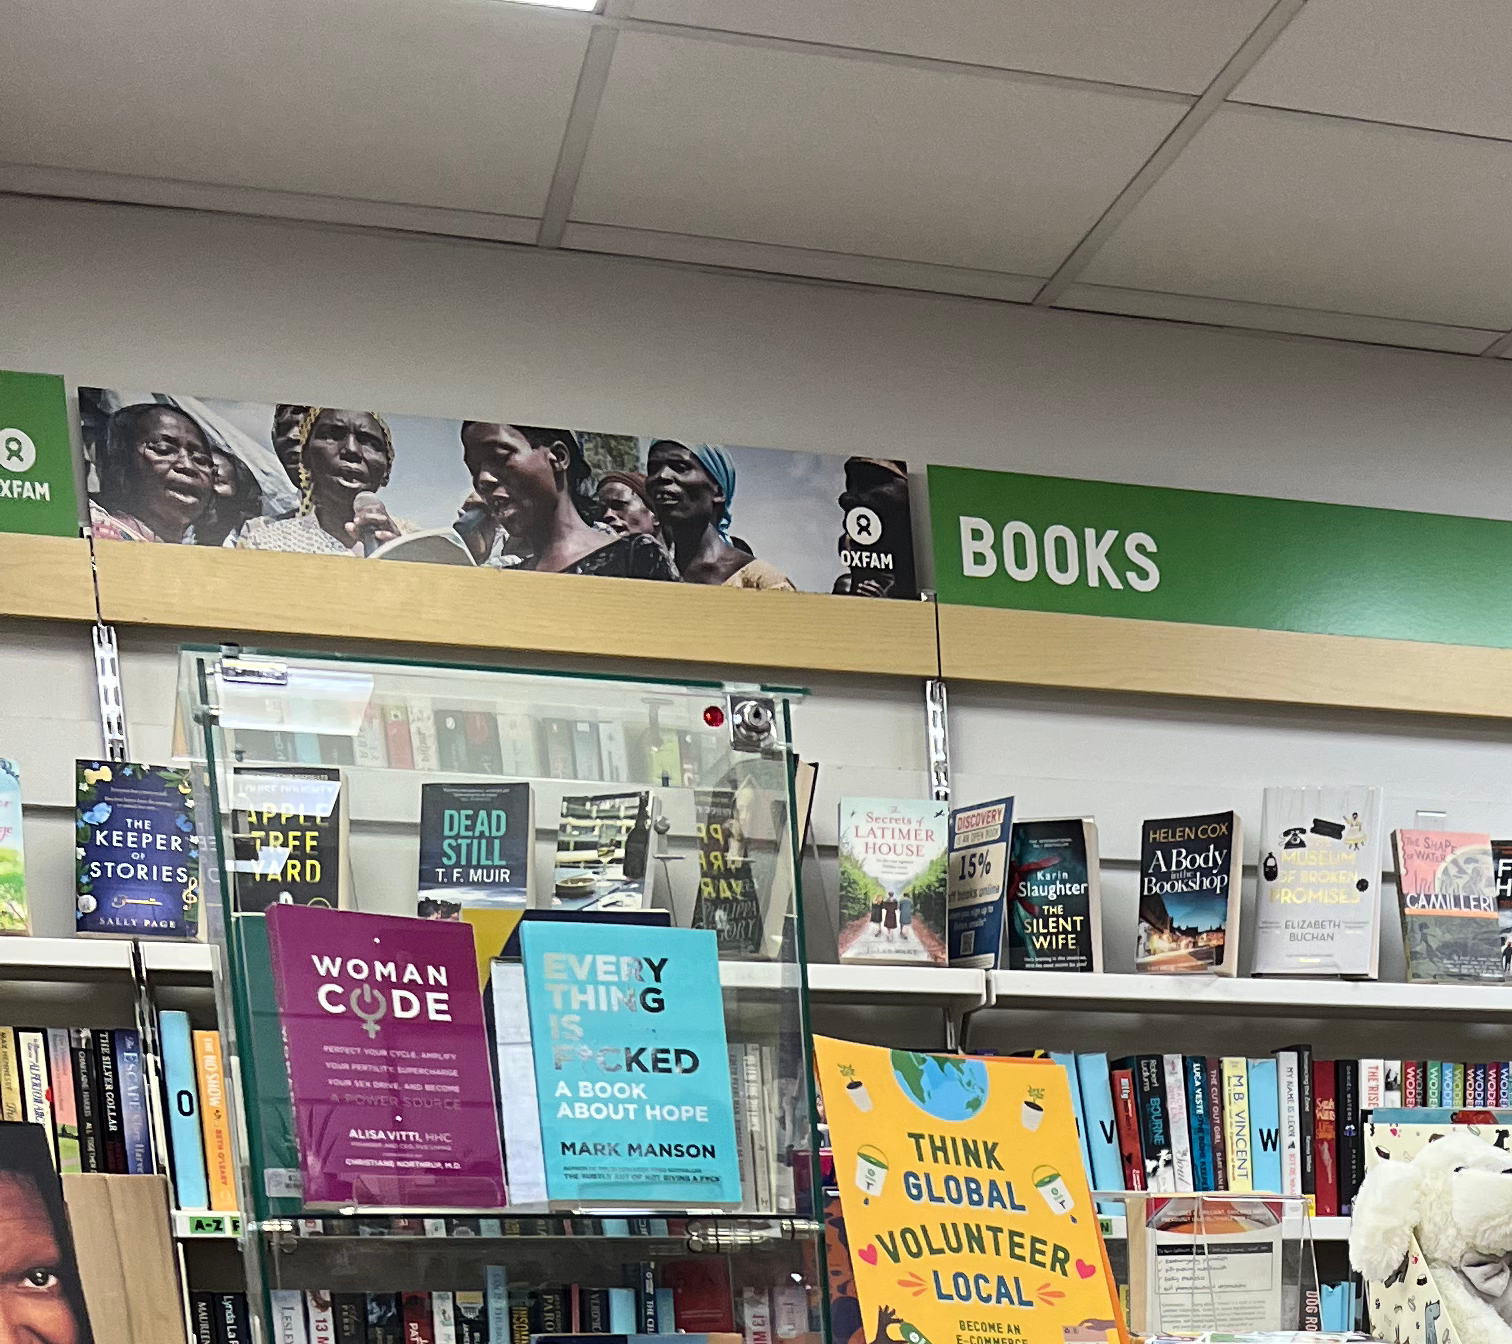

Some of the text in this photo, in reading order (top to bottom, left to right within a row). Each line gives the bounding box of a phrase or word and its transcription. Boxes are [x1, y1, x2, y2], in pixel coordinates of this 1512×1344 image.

[0, 479, 50, 501] XFAM
[841, 550, 893, 569] OXFAM
[959, 516, 1160, 592] BOOKS
[125, 818, 151, 831] THE
[443, 809, 506, 837] DEAD
[854, 825, 936, 842] LATIMER
[1150, 822, 1228, 843] HELEN COX
[95, 829, 183, 852] KEEPER
[864, 842, 925, 857] HOUSE
[131, 852, 145, 861] OF
[442, 839, 506, 866] STILL
[1148, 844, 1228, 875] A Body
[89, 861, 188, 884] STORIES
[1143, 871, 1228, 896] Bookshop
[1017, 881, 1088, 900] Slaughter
[1042, 905, 1063, 915] THE
[1406, 893, 1494, 912] CAMILLERI
[1023, 916, 1084, 934] SILENT
[1032, 934, 1077, 950] WIFE
[311, 955, 448, 986] WOMAN
[544, 953, 668, 983] EVERY
[317, 983, 452, 1030] CODE
[544, 983, 665, 1013] THING
[549, 1014, 584, 1041] IS
[555, 1081, 647, 1100] A BOOK
[557, 1102, 709, 1122] ABOUT HOPE
[1149, 1097, 1166, 1147] BOURNE
[560, 1141, 716, 1158] MARK MANSON
[907, 1132, 1005, 1172] THINK
[903, 1171, 1027, 1212] GLOBAL
[194, 1219, 223, 1232] A-Z
[874, 1222, 1071, 1277] VOLUNTEER
[931, 1269, 1035, 1308] LOCAL
